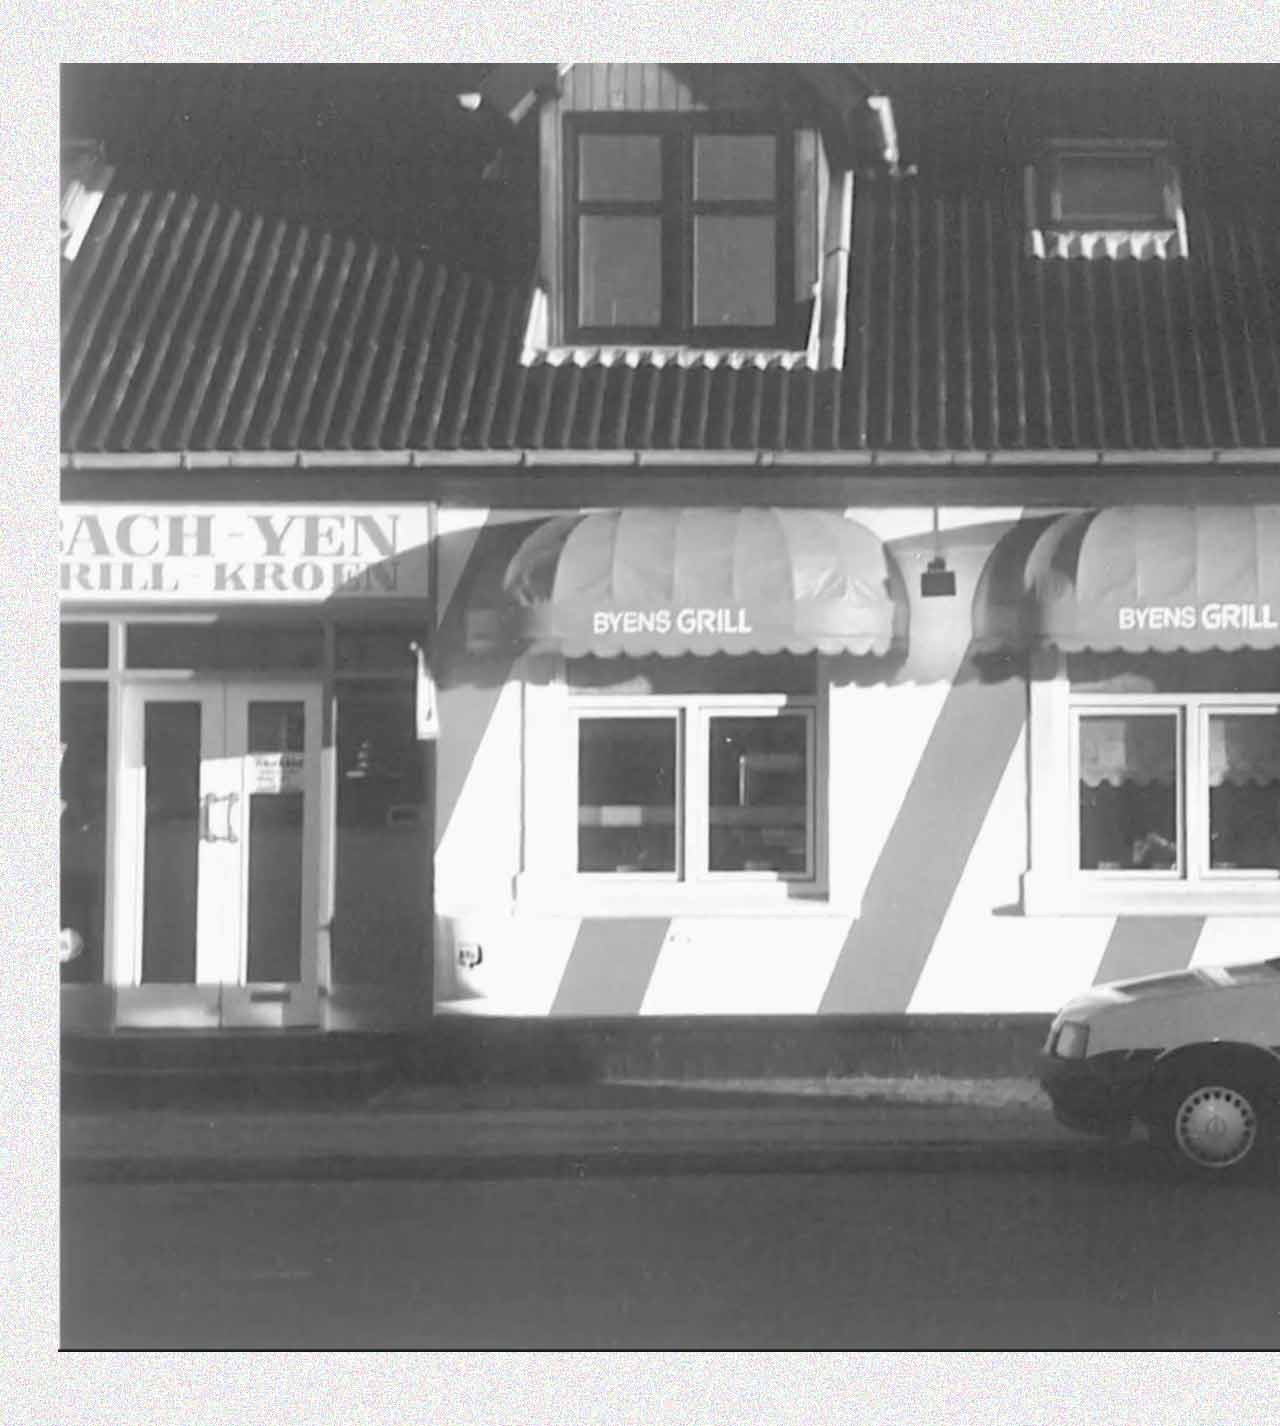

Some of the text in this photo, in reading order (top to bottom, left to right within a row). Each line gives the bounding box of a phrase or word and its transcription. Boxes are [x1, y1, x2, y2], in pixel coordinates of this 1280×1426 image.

[593, 608, 752, 635] BYENS GRILL
[1119, 603, 1279, 630] BYENS GRILL
